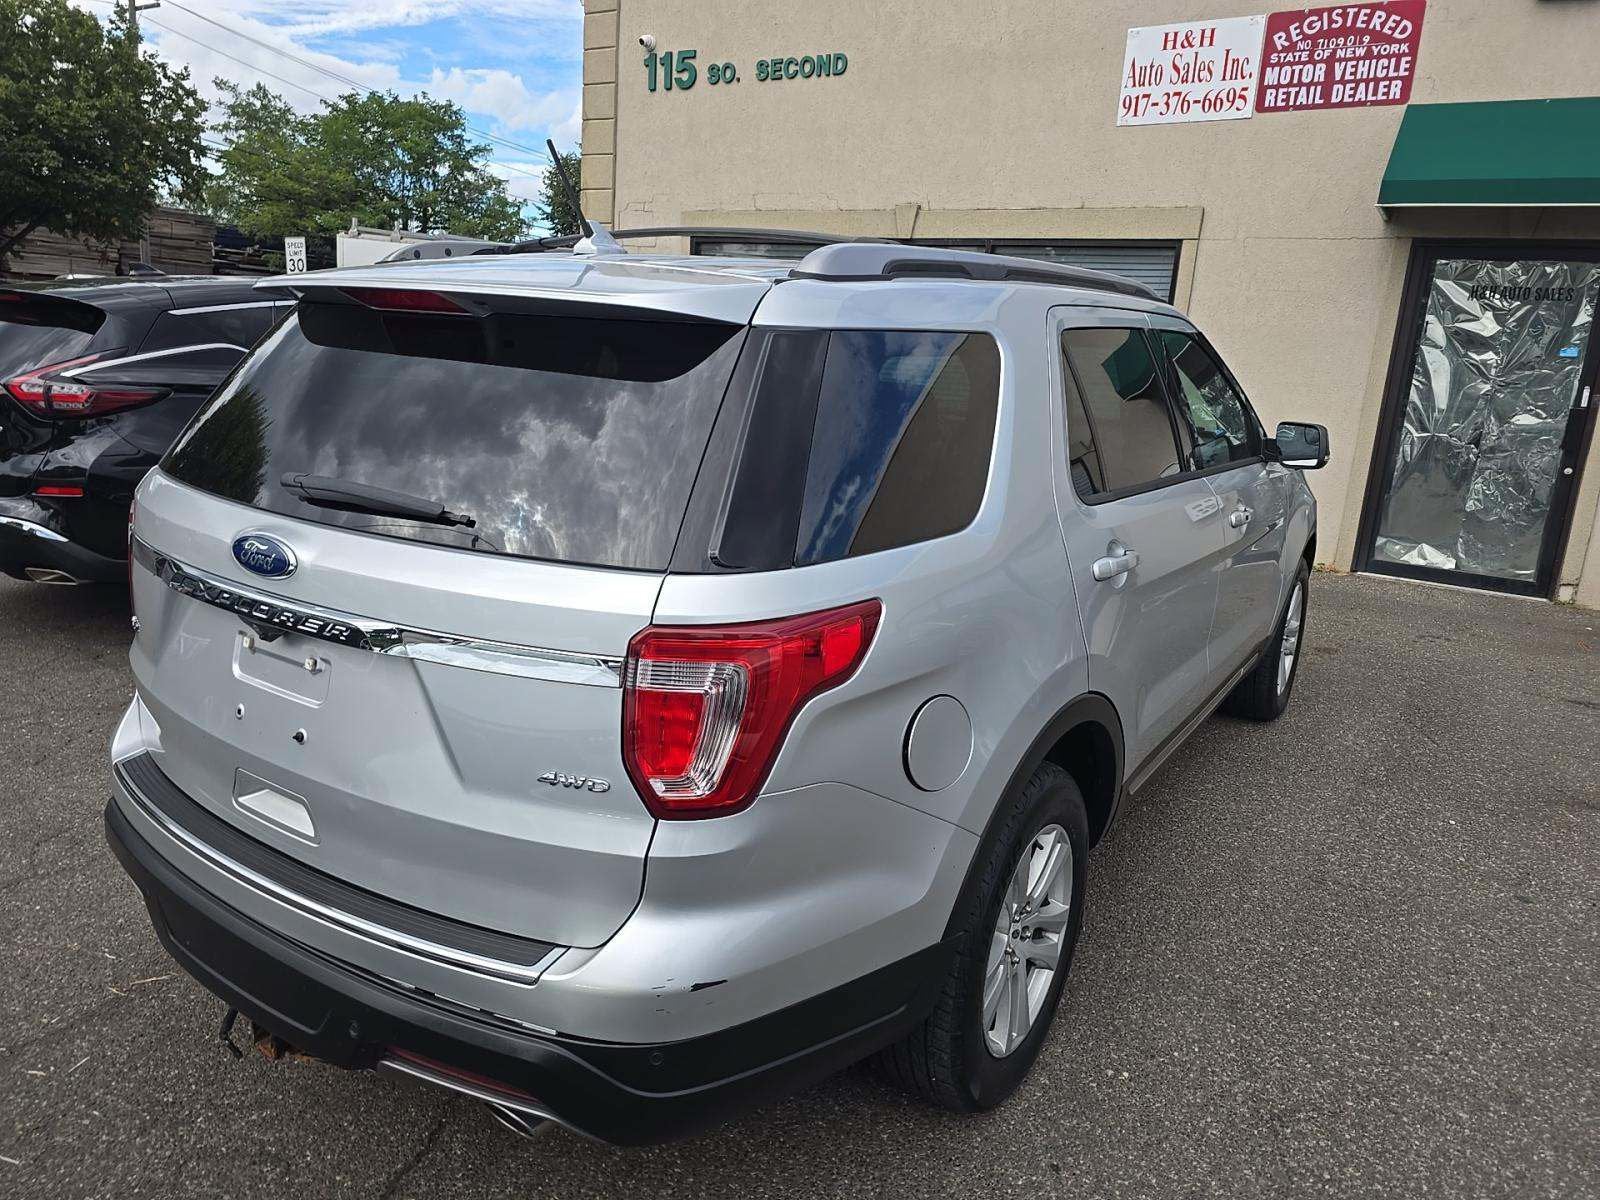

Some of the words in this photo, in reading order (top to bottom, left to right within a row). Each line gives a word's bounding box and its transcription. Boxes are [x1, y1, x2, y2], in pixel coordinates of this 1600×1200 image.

[1162, 27, 1216, 51] H&H
[1273, 7, 1413, 51] REGISTERED
[1270, 51, 1310, 64] STATE
[1314, 49, 1332, 60] OF
[1336, 47, 1368, 59] NEW
[1374, 42, 1410, 56] YORK
[643, 49, 699, 92] 115
[707, 62, 741, 85] SO.
[755, 53, 849, 82] SECOND
[1124, 56, 1164, 88] Auto
[1170, 51, 1215, 85] Sales
[1220, 48, 1253, 81] Inc.
[1264, 63, 1327, 86] MOTOR
[1334, 56, 1412, 81] VEHICLE
[1121, 86, 1250, 118] 917-376-6695
[1264, 85, 1325, 107] RETAIL
[1331, 79, 1403, 103] DEALER
[288, 249, 302, 257] LIMIT
[288, 258, 305, 272] 30
[1469, 284, 1499, 300] H&H
[1501, 286, 1531, 301] AUTO
[1534, 287, 1575, 301] SALES
[240, 540, 276, 570] Ford
[537, 771, 611, 793] 4WD
